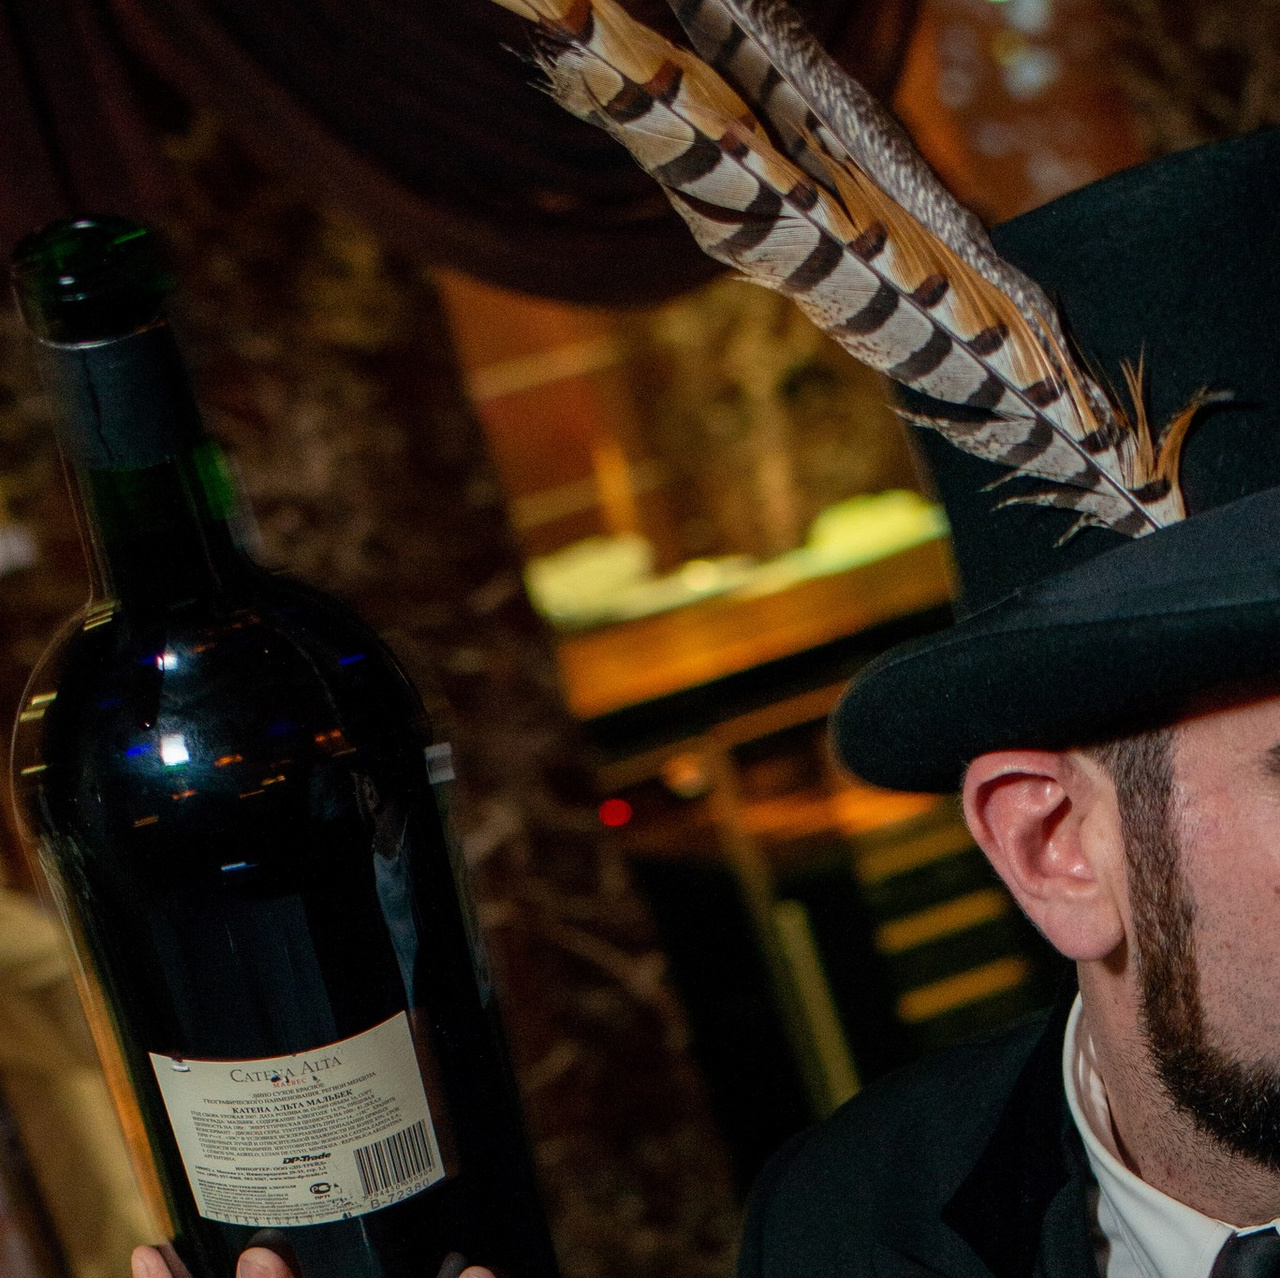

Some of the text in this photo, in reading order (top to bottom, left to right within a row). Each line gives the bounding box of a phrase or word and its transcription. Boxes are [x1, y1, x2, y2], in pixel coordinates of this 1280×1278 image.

[230, 1056, 342, 1082] CATENA ALTA
[273, 1101, 304, 1112] АЛЬТА
[306, 1088, 353, 1106] МАЛЬБЕК
[282, 1152, 331, 1164] DP-Trade
